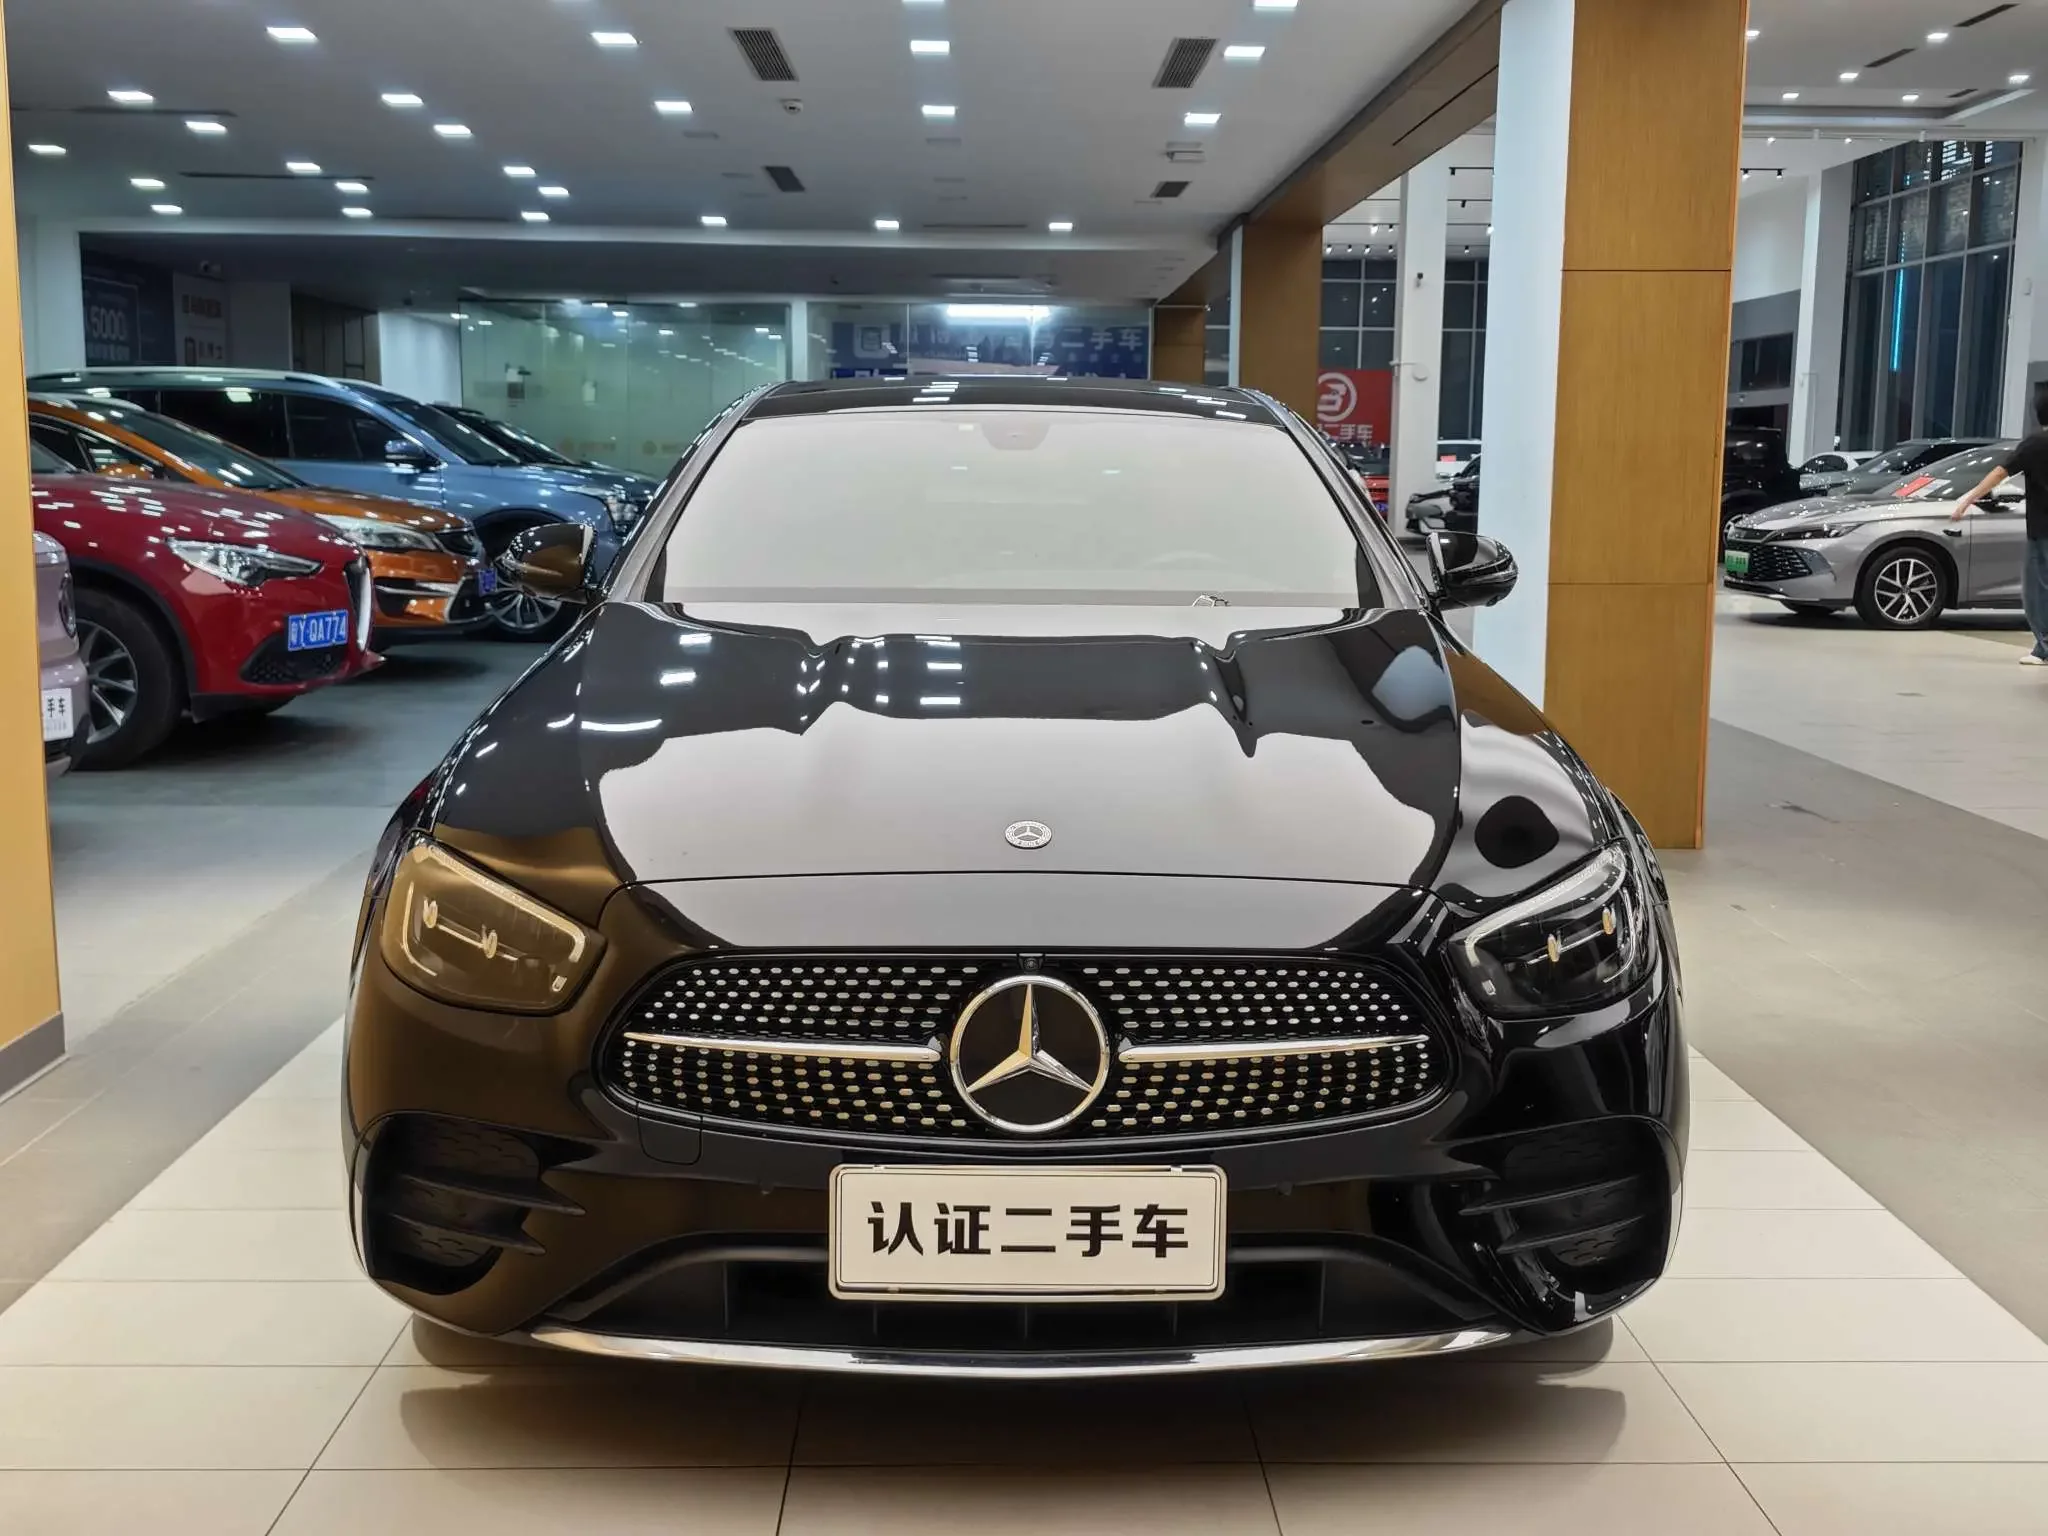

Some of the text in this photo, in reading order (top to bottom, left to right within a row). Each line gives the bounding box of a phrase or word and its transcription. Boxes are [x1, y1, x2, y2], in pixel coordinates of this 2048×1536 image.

[867, 1201, 1189, 1258] 认证二手车
